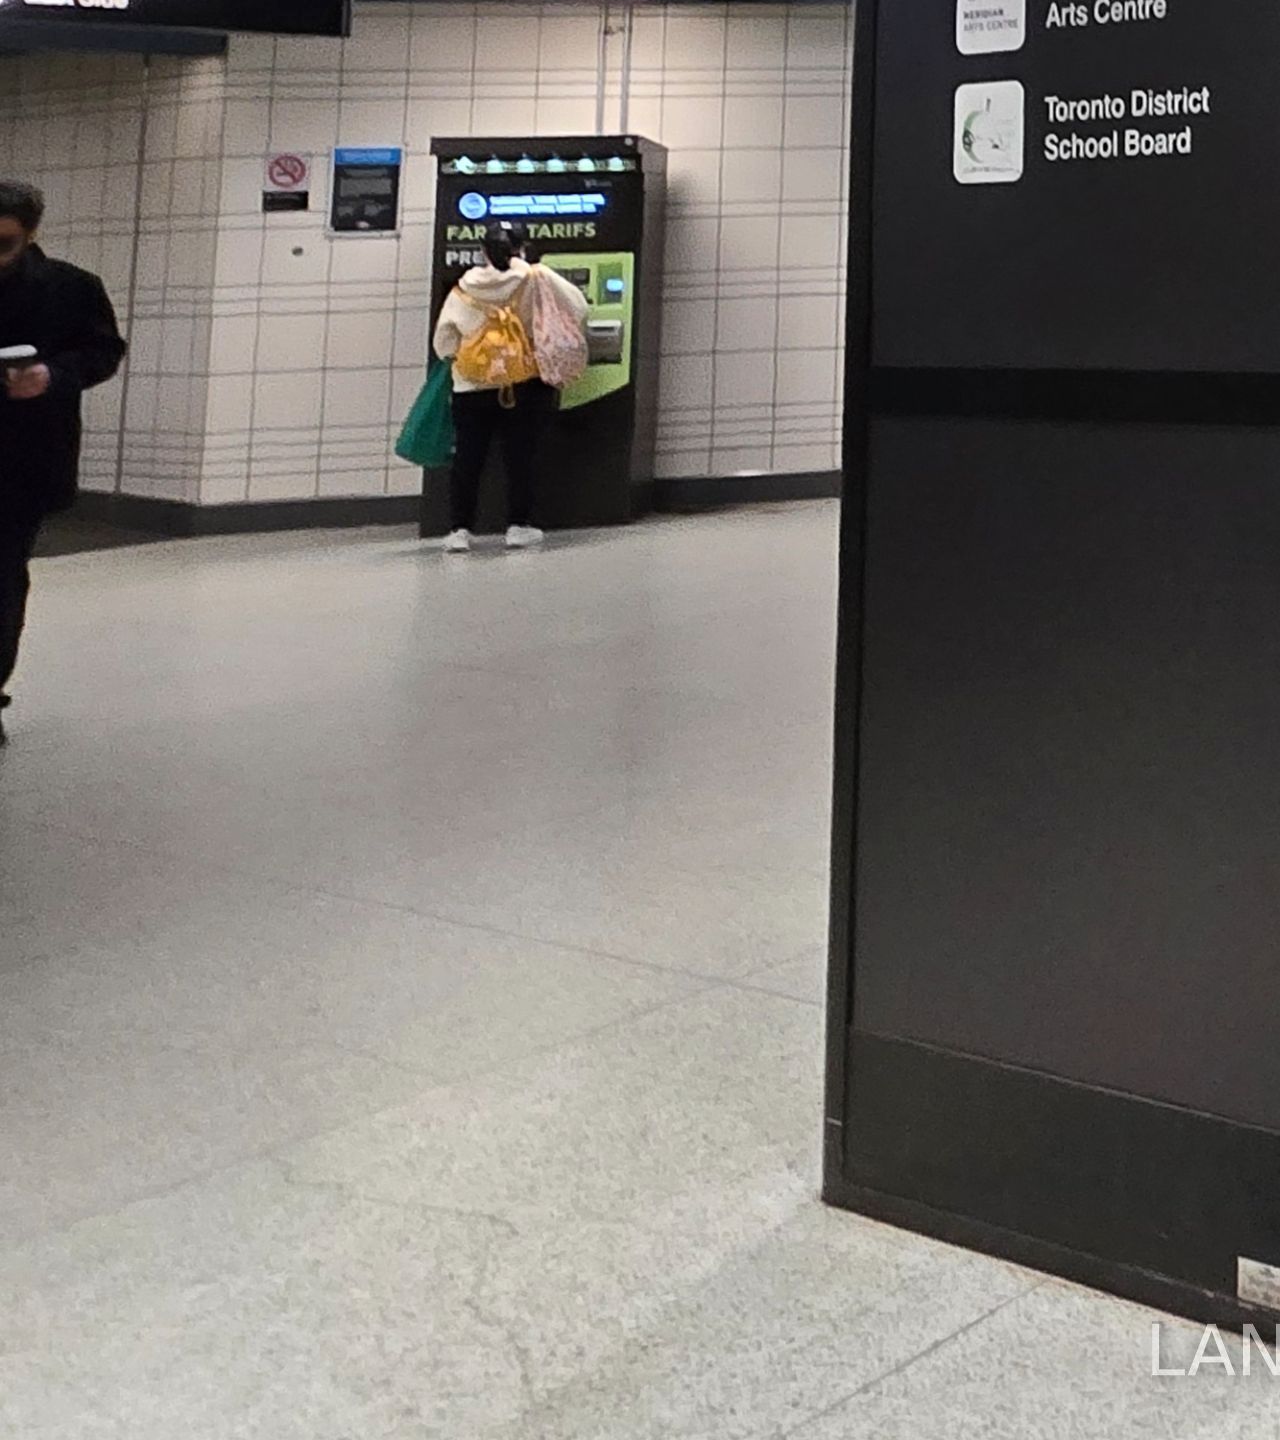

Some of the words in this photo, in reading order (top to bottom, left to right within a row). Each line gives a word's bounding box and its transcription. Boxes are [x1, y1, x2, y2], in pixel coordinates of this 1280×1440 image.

[1046, 2, 1088, 29] Arts
[1044, 93, 1126, 122] Toronto
[1130, 86, 1211, 117] District
[1043, 130, 1118, 161] School
[1123, 126, 1192, 157] Board
[446, 224, 488, 241] FAR
[526, 222, 597, 239] TARIFS
[445, 250, 488, 266] PRE
